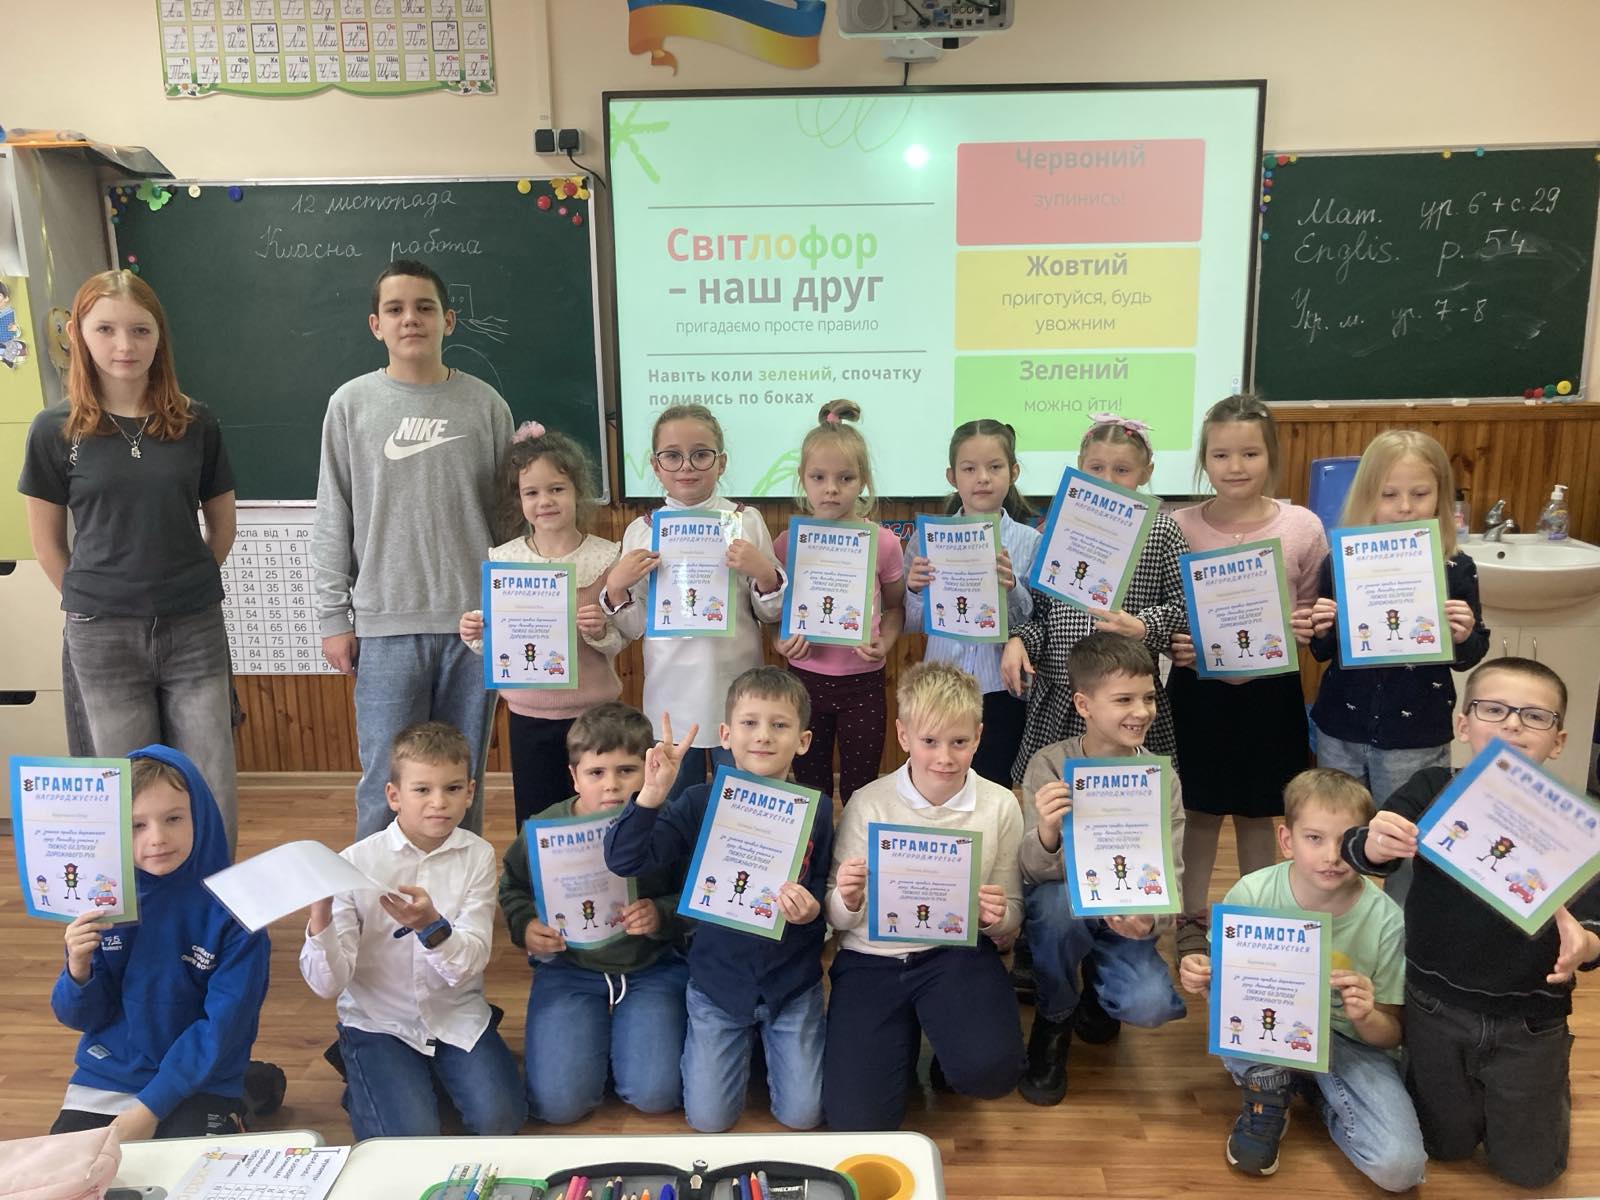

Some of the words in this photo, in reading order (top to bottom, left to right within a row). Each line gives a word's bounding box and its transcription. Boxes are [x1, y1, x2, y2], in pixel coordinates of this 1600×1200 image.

[1015, 144, 1145, 176] Червоний
[291, 193, 315, 214] 12
[325, 189, 456, 218] листопада
[1034, 191, 1125, 209] зупинись!
[1297, 197, 1382, 226] Мат.
[1468, 191, 1486, 214] 6
[1530, 187, 1560, 214] 29
[255, 225, 362, 258] Класна
[391, 228, 482, 262] робота
[667, 224, 877, 270] Світлофор
[1026, 253, 1127, 277] Жовтий
[1294, 232, 1399, 284] Englis.
[1479, 229, 1525, 258] 54
[699, 277, 781, 304] наш
[792, 275, 883, 313] друг
[1002, 290, 1107, 309] приготуйся,
[1112, 289, 1152, 305] будь
[676, 320, 760, 335] пригадаємо
[765, 319, 813, 335] просте
[818, 319, 878, 334] правило
[1035, 318, 1115, 335] уважним
[648, 368, 705, 383] Навіть
[711, 368, 752, 382] коли
[758, 366, 837, 383] зелений,
[842, 366, 921, 384] спочатку
[1019, 358, 1129, 381] Зелений
[649, 391, 733, 407] подивись
[738, 393, 759, 405] по
[764, 389, 814, 405] боках
[1024, 399, 1082, 413] можна
[1088, 397, 1122, 413] йти!
[395, 417, 448, 441] NIKE
[1078, 488, 1134, 519] ГРАМОТА
[263, 529, 278, 538] від
[285, 529, 289, 537] 1
[296, 529, 309, 538] до
[669, 524, 721, 536] ГРАМОТА
[934, 530, 986, 543] ГРАМОТА
[241, 544, 248, 552] 4
[266, 543, 272, 552] 5
[290, 543, 297, 552] 6
[808, 532, 859, 547] ГРАМОТА
[1355, 537, 1418, 554] ГРАМОТА
[241, 557, 252, 565] 14
[265, 557, 276, 566] 15
[289, 556, 301, 566] 16
[1203, 557, 1263, 579] ГРАМОТА
[241, 570, 253, 579] 24
[265, 570, 278, 579] 25
[289, 570, 302, 579] 26
[502, 576, 558, 589] ГРАМОТА
[243, 583, 255, 592] 34
[266, 583, 279, 593] 35
[291, 583, 304, 592] 36
[244, 597, 256, 605] 44
[268, 597, 280, 606] 45
[292, 596, 305, 605] 46
[246, 610, 257, 619] 54
[269, 610, 282, 619] 55
[293, 610, 306, 619] 56
[247, 623, 258, 632] 64
[270, 623, 283, 632] 65
[294, 623, 307, 632] 66
[248, 636, 260, 645] 74
[271, 636, 284, 645] 75
[295, 636, 308, 645] 76
[249, 649, 261, 658] 84
[272, 649, 285, 658] 85
[297, 649, 309, 658] 86
[250, 662, 262, 671] 94
[274, 662, 287, 671] 95
[298, 662, 310, 671] 96
[35, 776, 105, 792] ГРАМОТА
[1086, 774, 1148, 789] ГРАМОТА
[732, 787, 795, 816] ГРАМОТА
[892, 838, 958, 855] ГРАМОТА
[1236, 924, 1306, 943] ГРАМОТА
